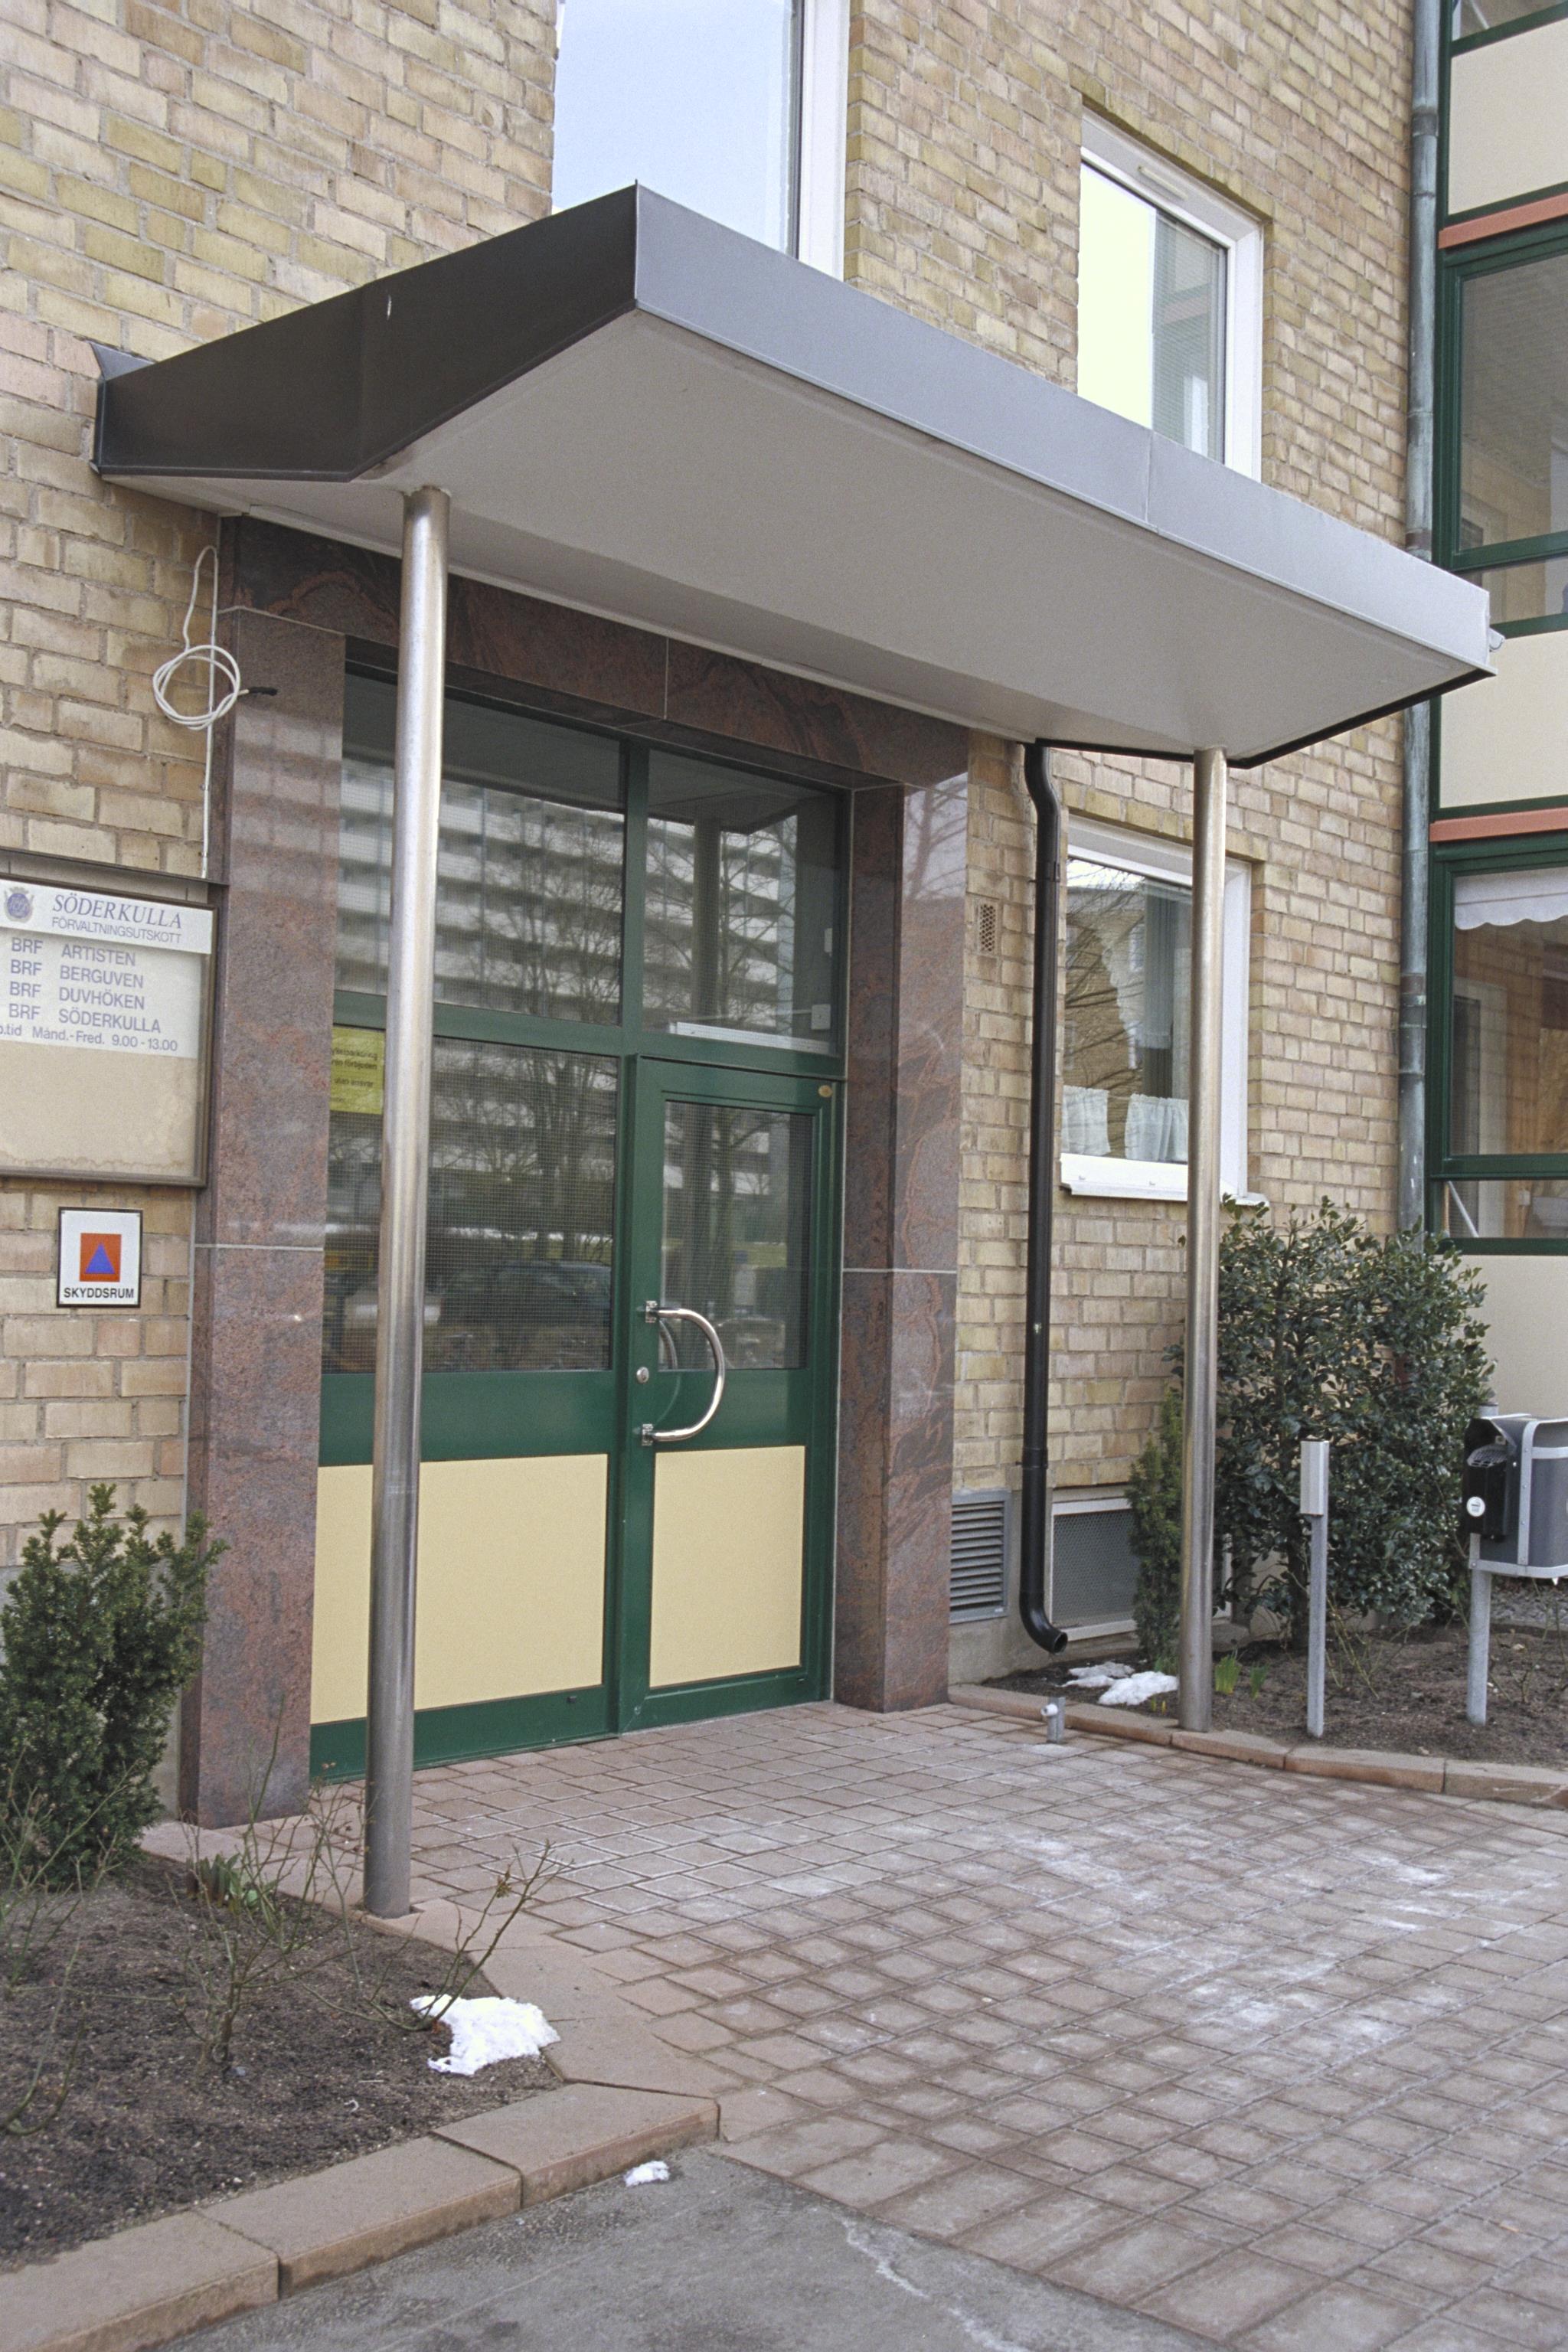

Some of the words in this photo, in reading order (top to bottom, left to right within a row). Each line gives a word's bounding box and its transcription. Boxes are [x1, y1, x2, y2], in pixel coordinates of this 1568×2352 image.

[52, 893, 181, 929] SÖDERKULLA
[51, 916, 182, 944] FÖRVALTNINGSUTSKOTT
[11, 937, 44, 955] BRF
[61, 943, 136, 967] ARTISTEN
[10, 959, 42, 976] BRF
[60, 965, 144, 988] BERGUVEN
[9, 981, 41, 998] BRF
[59, 986, 145, 1011] DUVHÖKEN
[8, 1003, 41, 1021] BRF
[58, 1006, 161, 1034] SÖDERKULLA
[112, 1034, 139, 1048] 9.00
[147, 1037, 178, 1052] 13.00
[64, 1287, 135, 1299] SKYDDSRUM
